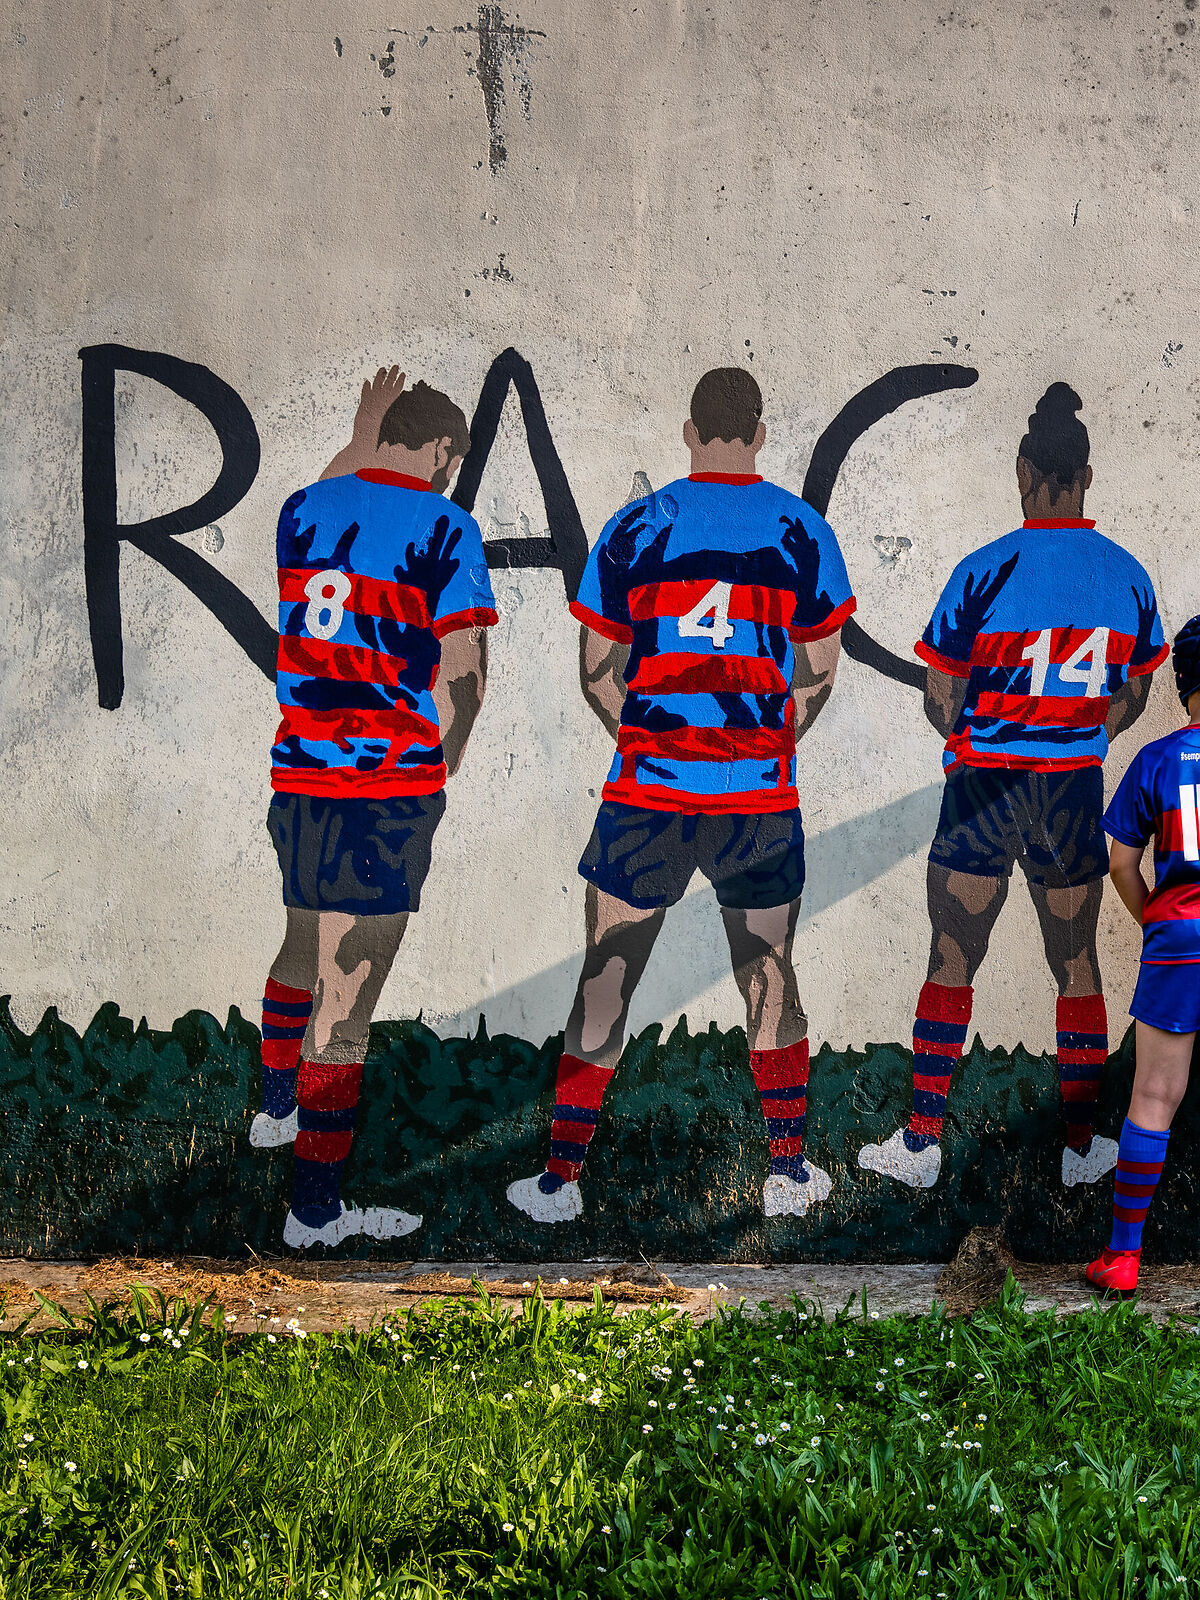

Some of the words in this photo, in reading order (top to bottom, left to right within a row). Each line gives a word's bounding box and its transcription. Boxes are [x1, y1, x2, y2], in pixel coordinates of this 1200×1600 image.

[303, 570, 351, 640] 8
[677, 580, 734, 648] 4
[1021, 626, 1109, 698] 14
